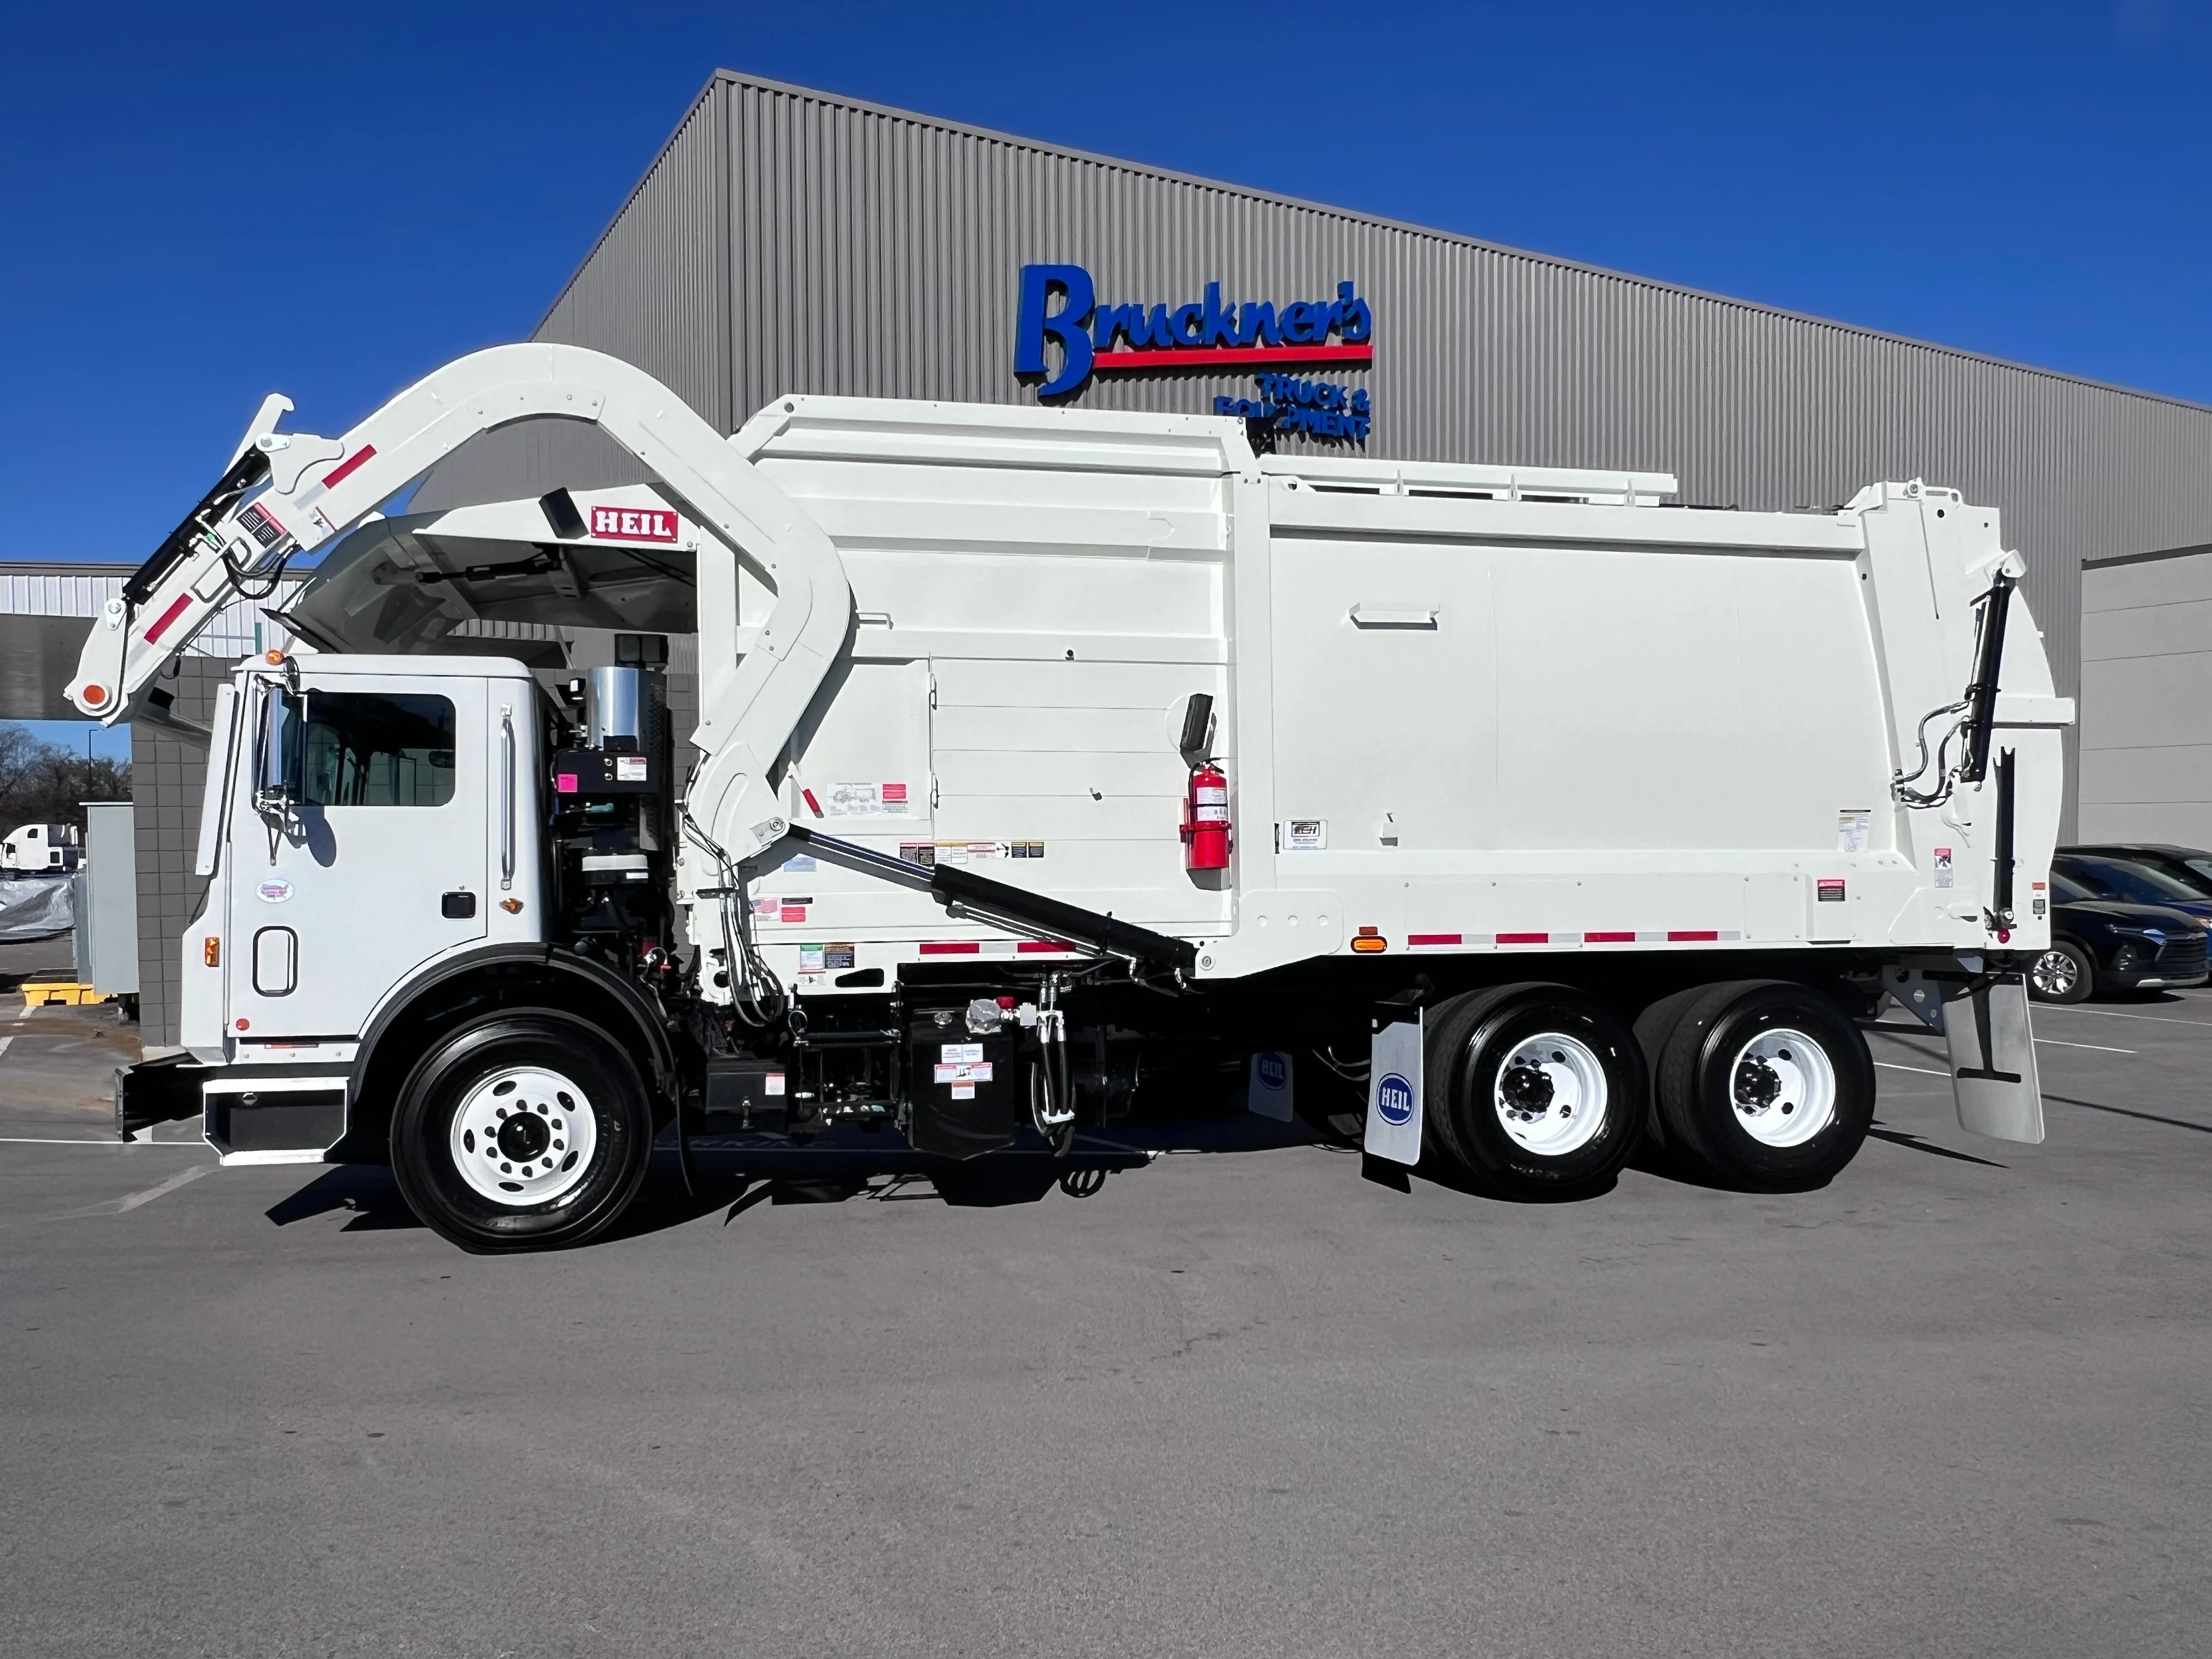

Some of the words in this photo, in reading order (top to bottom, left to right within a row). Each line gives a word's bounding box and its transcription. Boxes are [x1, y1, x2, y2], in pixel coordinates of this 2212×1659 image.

[1014, 264, 1371, 396] Bruckner's
[1256, 373, 1347, 408] TRUCK
[1351, 388, 1370, 411] &
[1213, 396, 1370, 438] EQUPMENT
[595, 511, 672, 537] HEIL
[1261, 1059, 1284, 1080] HEIL
[1381, 1087, 1410, 1111] HEIL
